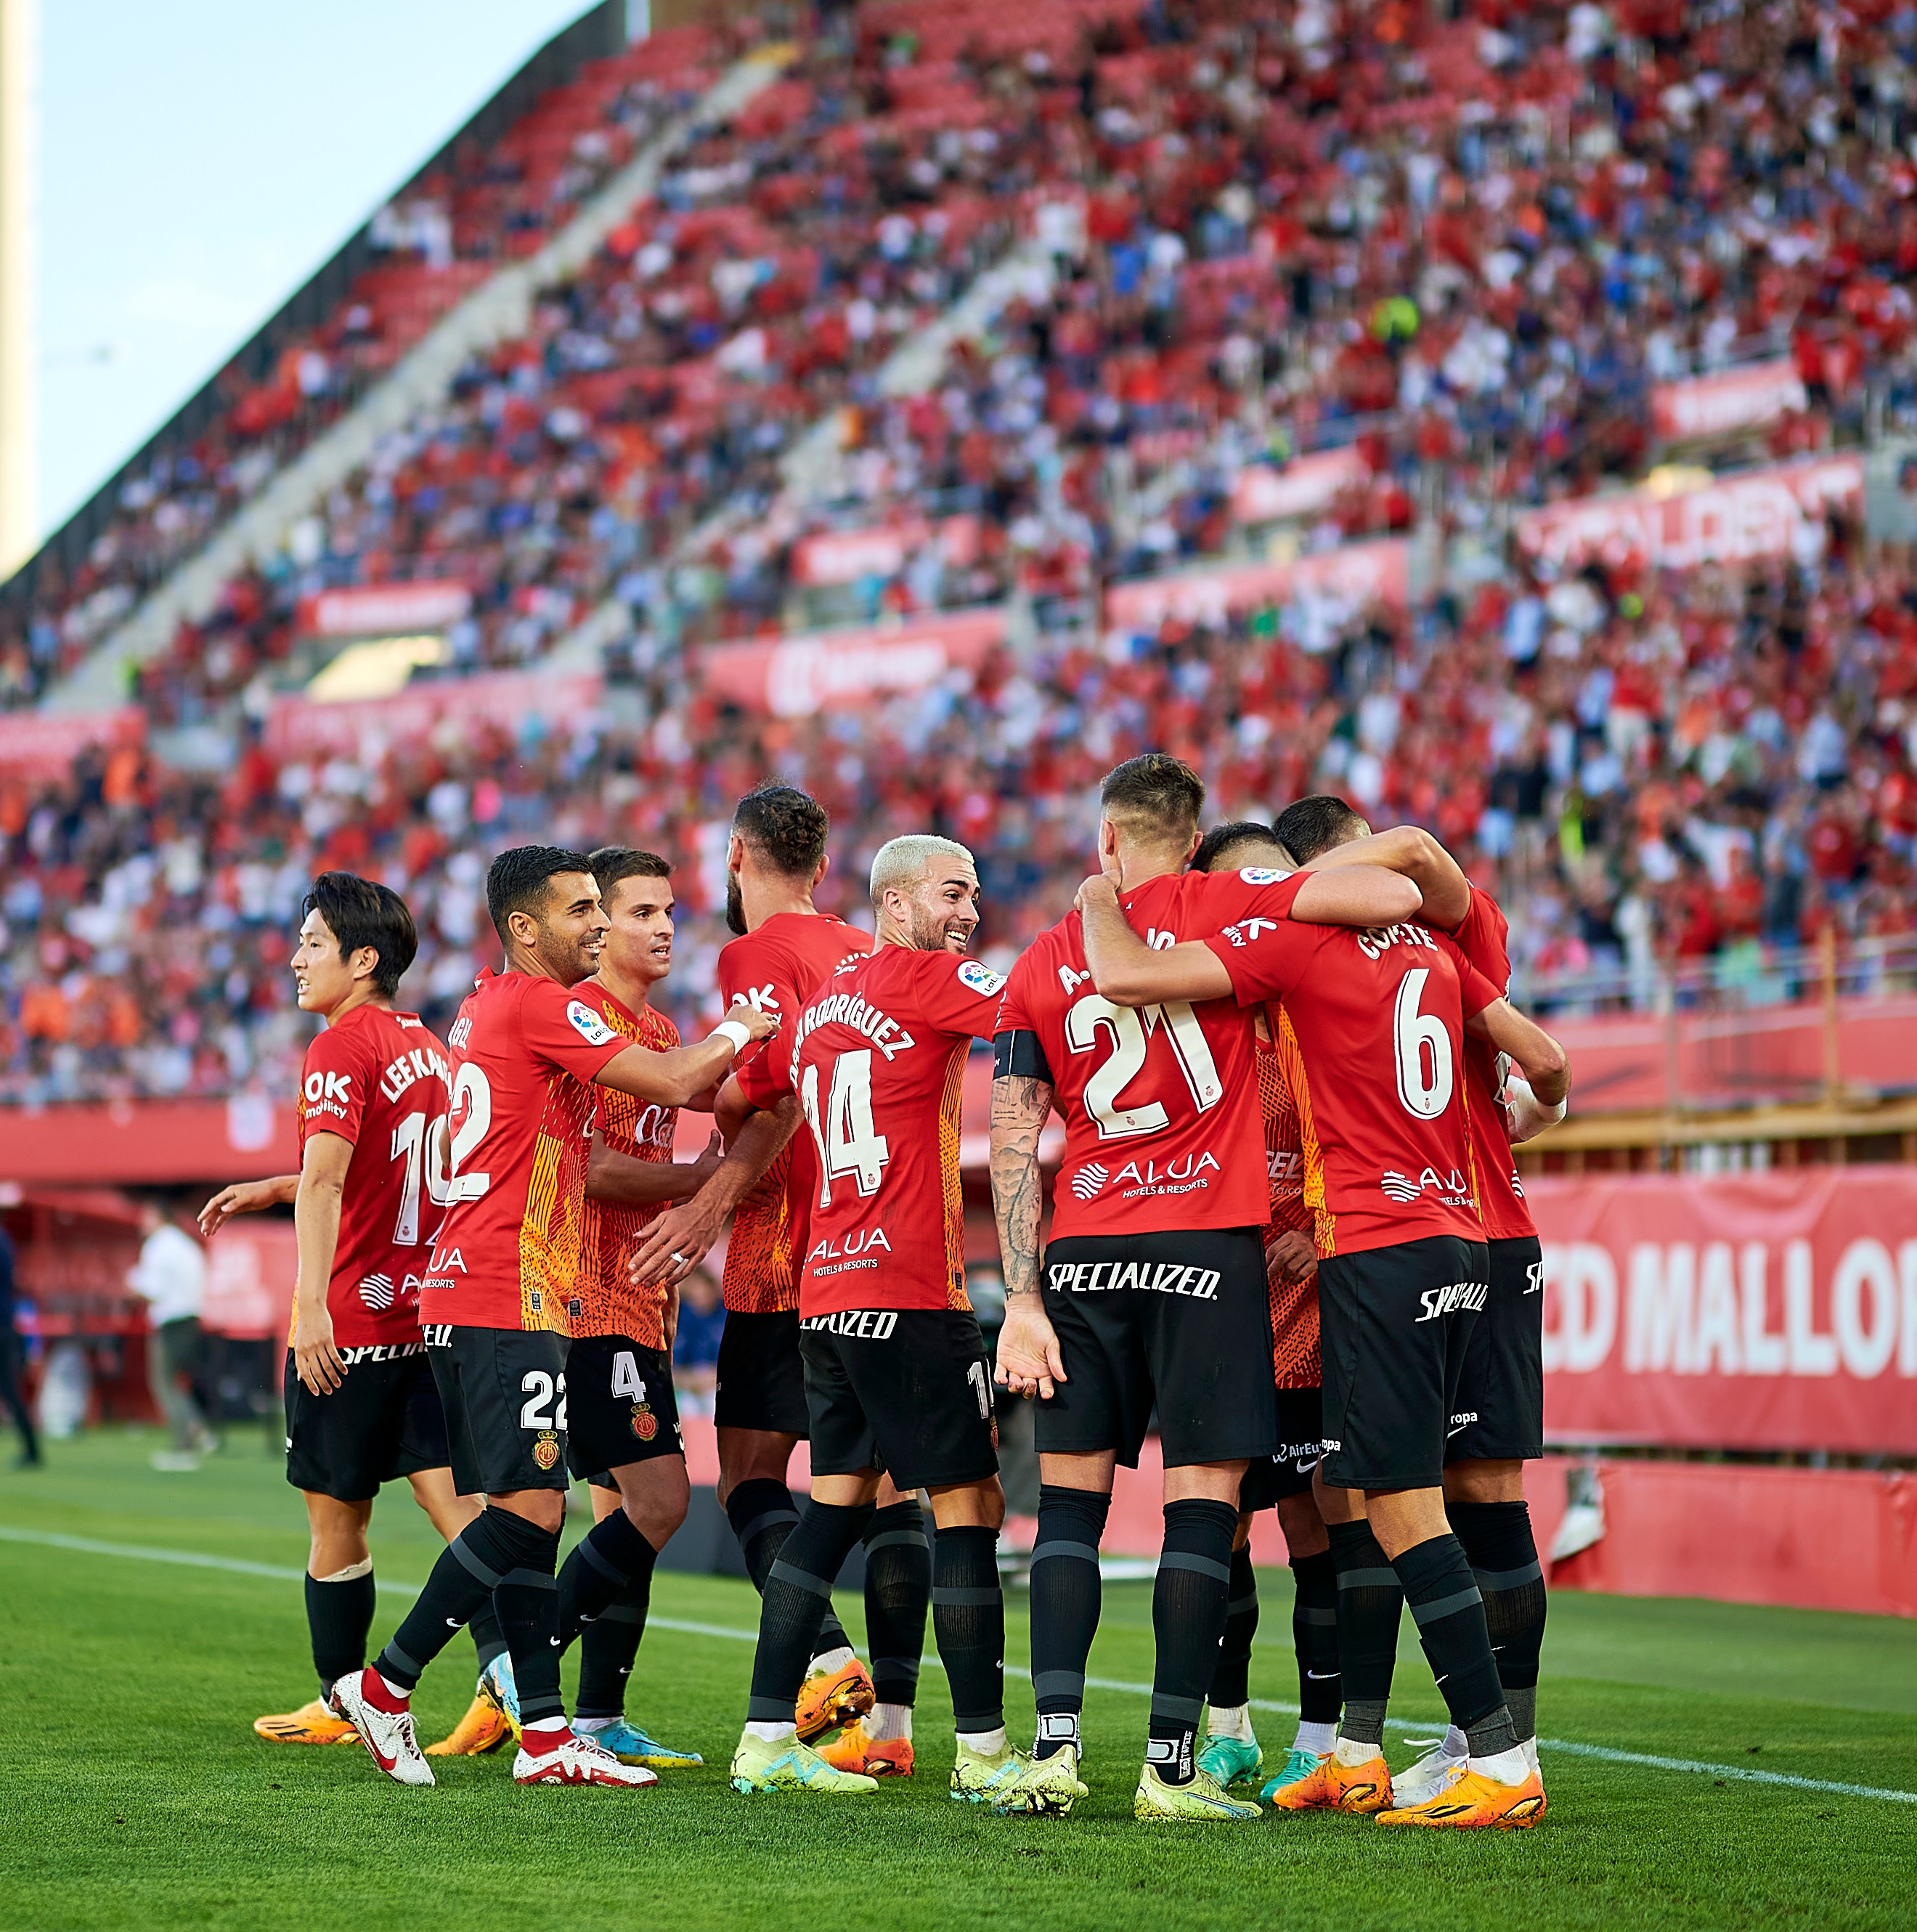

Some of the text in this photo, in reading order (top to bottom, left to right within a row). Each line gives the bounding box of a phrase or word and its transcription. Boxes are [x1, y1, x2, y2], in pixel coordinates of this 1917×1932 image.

[805, 991, 915, 1061] RODRÍGUEZ
[1393, 968, 1452, 1120] 6
[1065, 994, 1223, 1140] 21
[304, 1071, 351, 1104] OK
[306, 1098, 348, 1120] mobility
[800, 1048, 890, 1209] 14
[1112, 1151, 1221, 1185] ALUA
[1123, 1178, 1208, 1199] HOTELS & RESORTS
[1271, 1182, 1302, 1195] Taica
[807, 1227, 892, 1263] ALUA
[813, 1258, 878, 1278] HOTELS & RESORTS
[611, 1351, 646, 1403] 4
